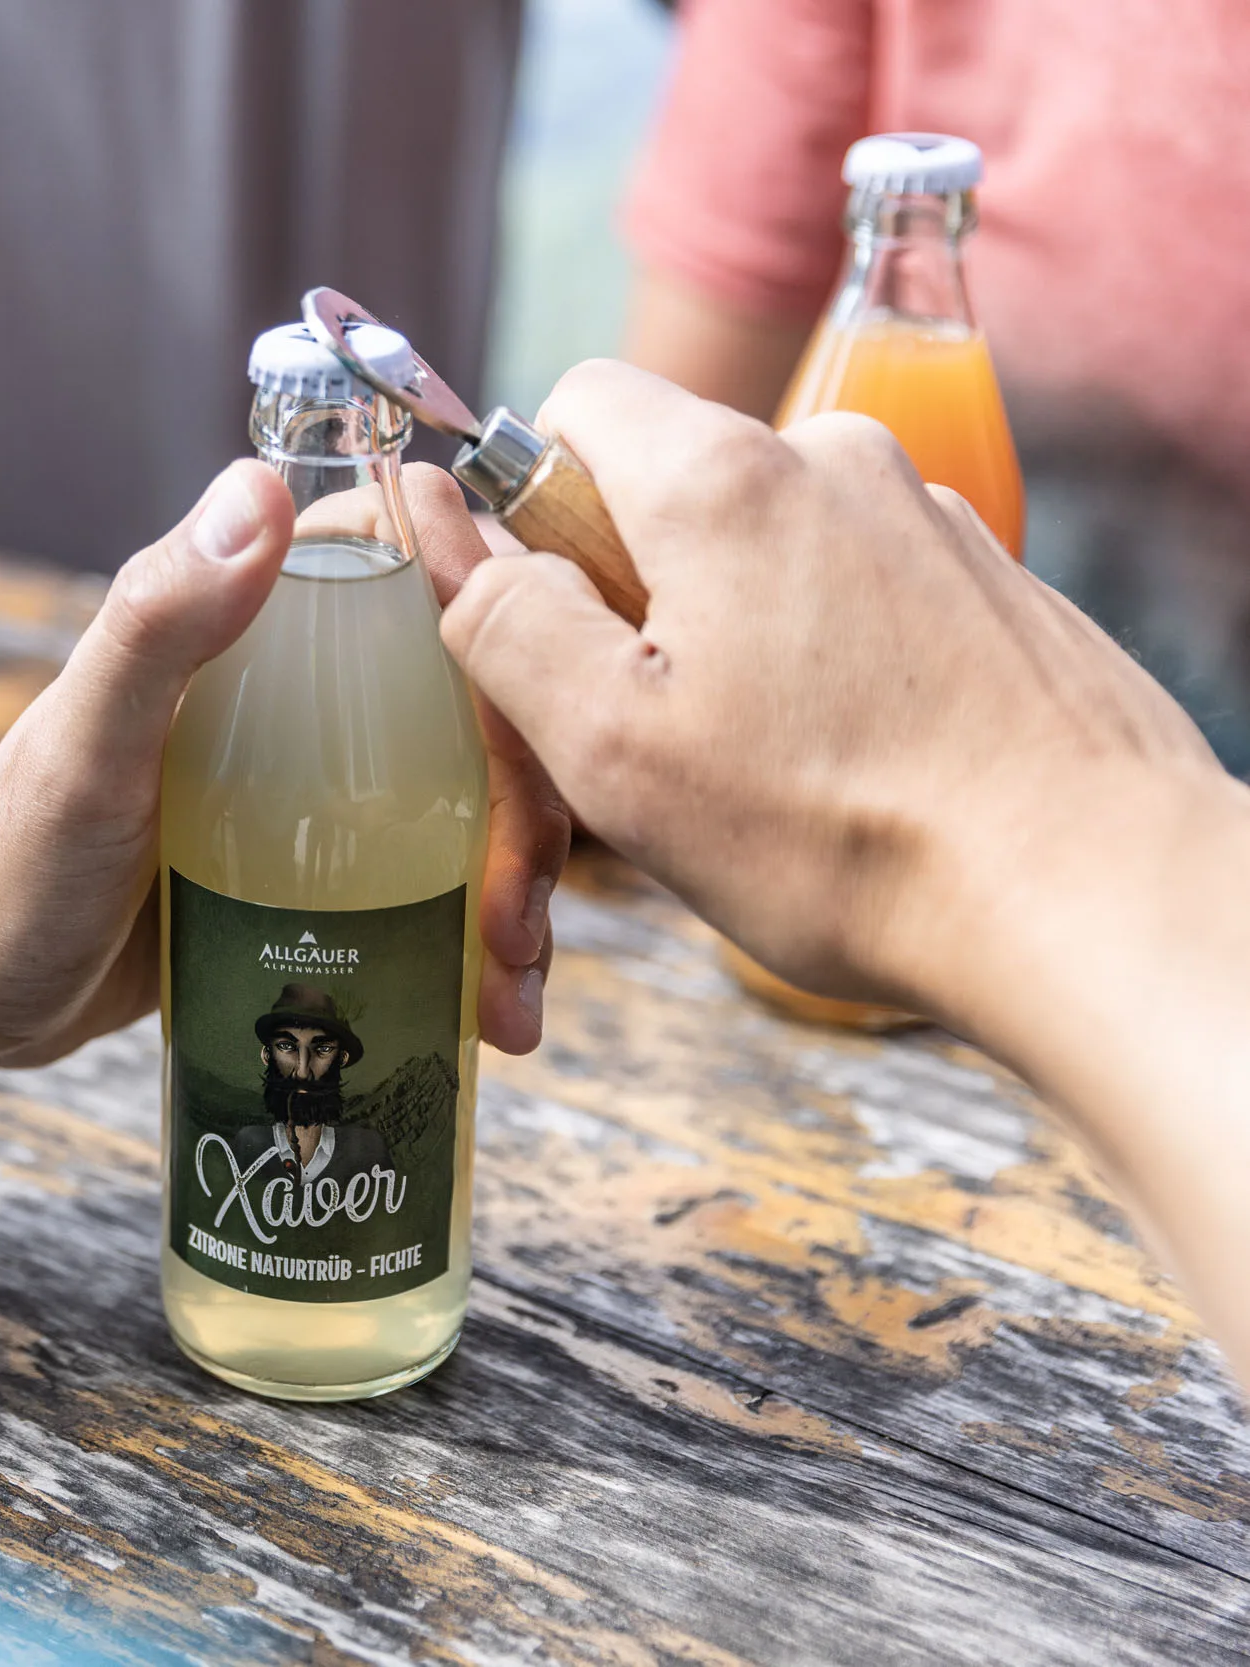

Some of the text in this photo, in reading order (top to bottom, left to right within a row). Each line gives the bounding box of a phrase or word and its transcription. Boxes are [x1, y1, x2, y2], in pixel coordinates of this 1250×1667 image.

[259, 943, 360, 963] ALLGÄUER
[263, 962, 354, 974] ALPENWASSER
[195, 1133, 407, 1244] Xaver
[188, 1224, 247, 1271] ZITRONE
[251, 1252, 352, 1281] NATURTRÜB
[370, 1244, 422, 1278] FICHTE
